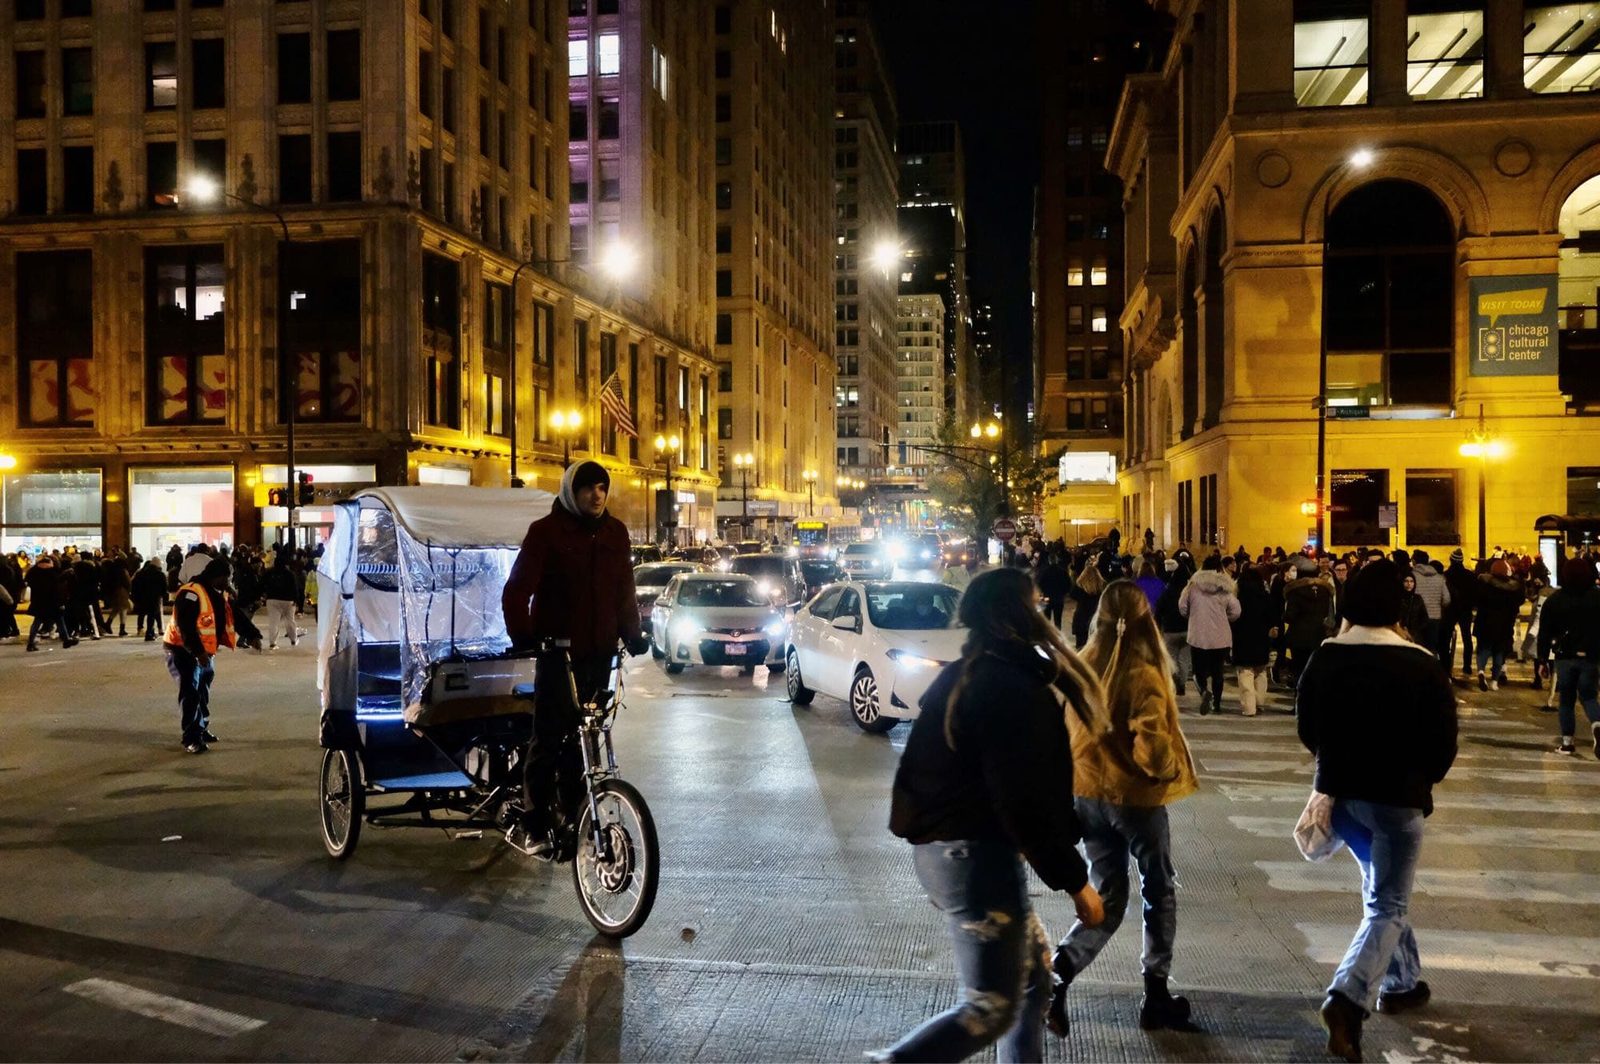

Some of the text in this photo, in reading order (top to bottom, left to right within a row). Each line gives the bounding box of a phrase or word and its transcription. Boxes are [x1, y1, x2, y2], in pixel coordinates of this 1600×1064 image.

[1481, 301, 1506, 310] VISIT
[1508, 324, 1549, 336] chicago
[1508, 336, 1549, 348] cultural
[1508, 350, 1541, 360] center
[26, 506, 45, 520] eat
